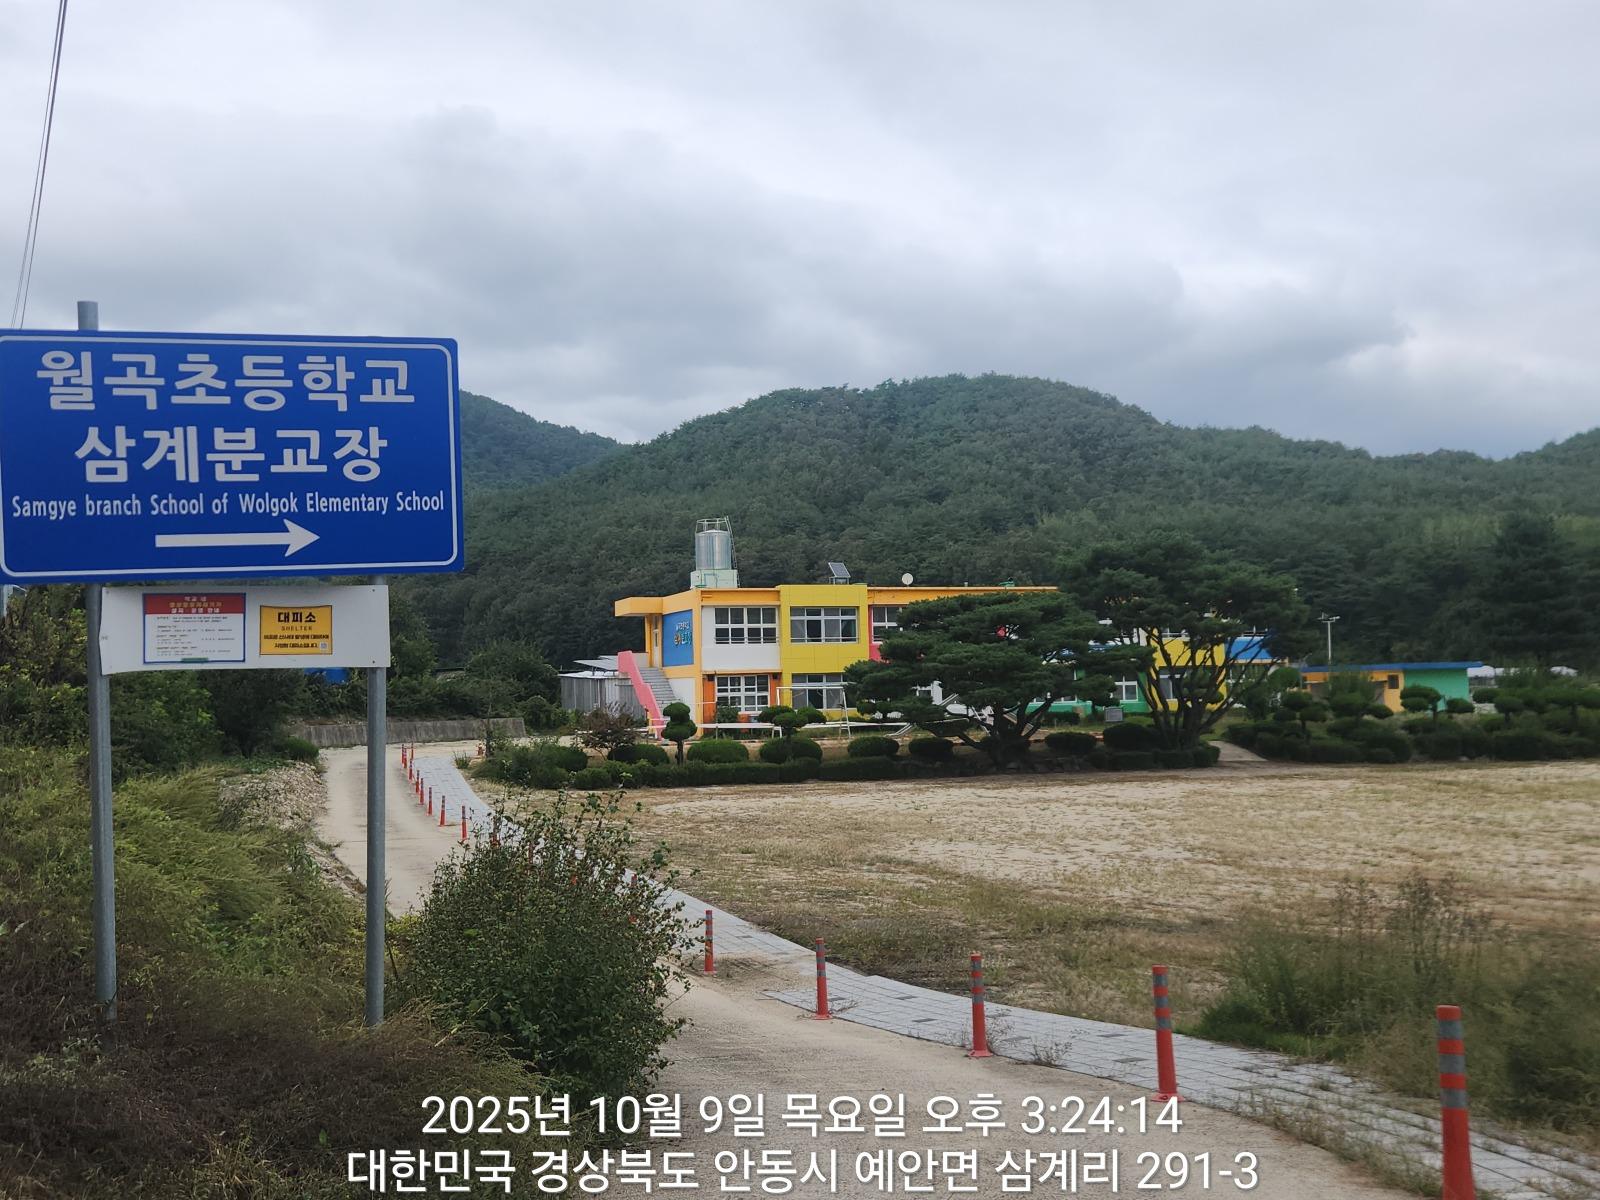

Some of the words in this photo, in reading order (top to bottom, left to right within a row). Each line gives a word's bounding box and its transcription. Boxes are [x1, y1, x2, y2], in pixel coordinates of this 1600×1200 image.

[37, 350, 415, 412] 월곡초등학교
[74, 425, 388, 483] 삼계분교장
[12, 495, 77, 520] Samgye
[85, 494, 142, 516] branch
[150, 493, 204, 515] School
[212, 492, 229, 514] of
[238, 492, 298, 517] Wolgok
[306, 491, 389, 515] Elementary
[396, 490, 444, 511] School
[277, 611, 317, 623] 대피소
